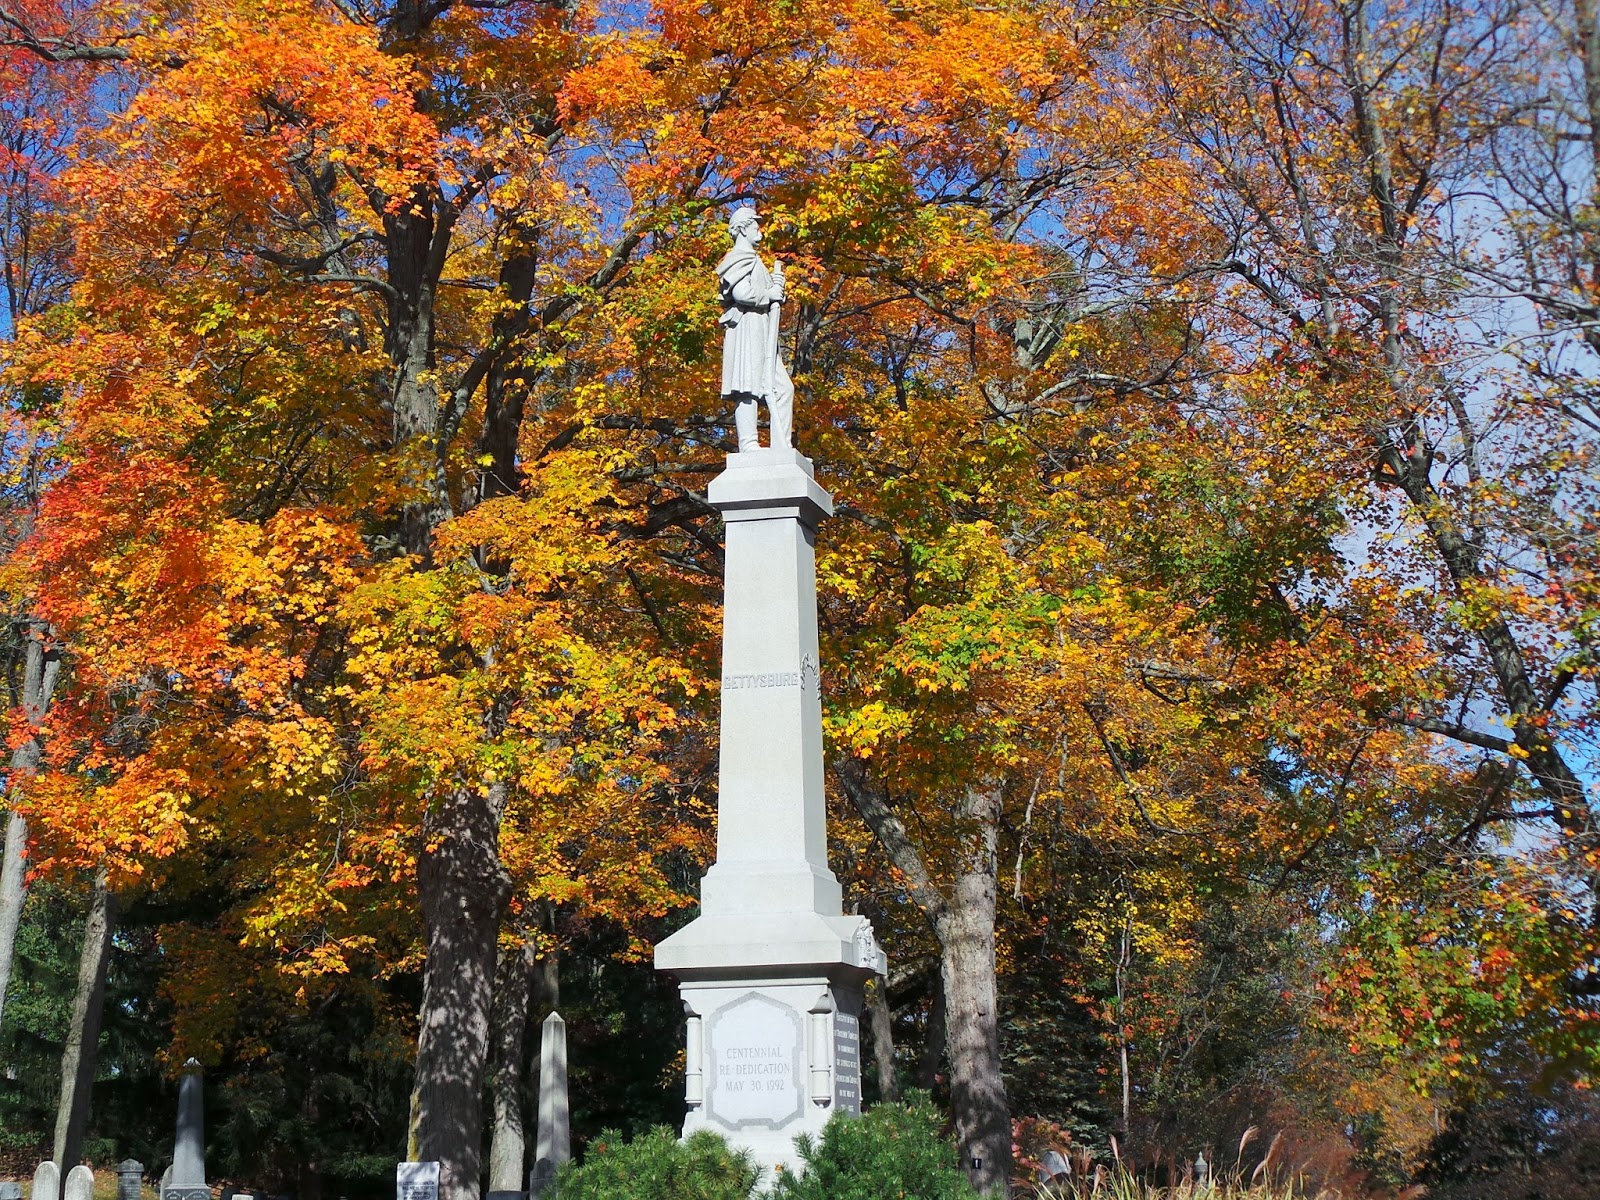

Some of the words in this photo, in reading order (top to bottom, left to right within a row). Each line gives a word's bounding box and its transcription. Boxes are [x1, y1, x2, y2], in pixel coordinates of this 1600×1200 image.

[724, 673, 798, 689] GETTYSBURG
[727, 1047, 782, 1059] CENTENNIAL
[726, 1081, 744, 1092] MAY
[767, 1080, 784, 1090] 1992
